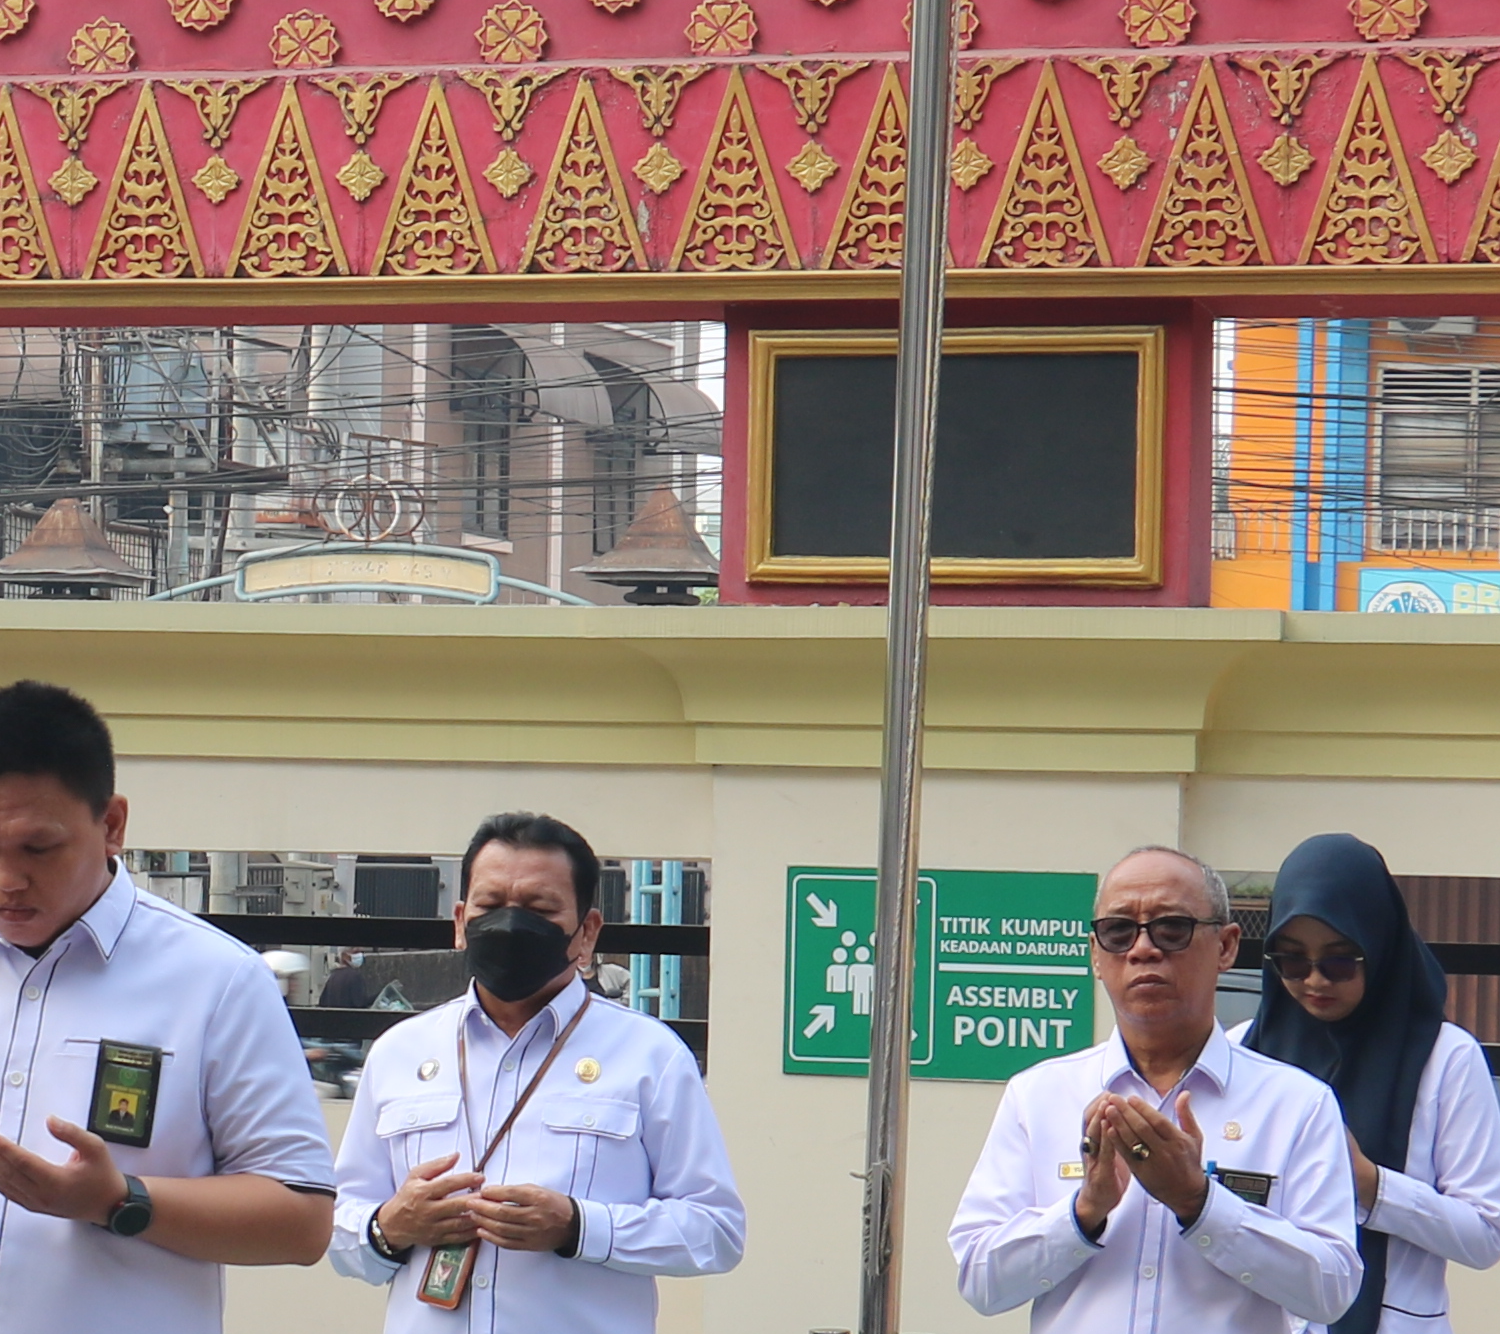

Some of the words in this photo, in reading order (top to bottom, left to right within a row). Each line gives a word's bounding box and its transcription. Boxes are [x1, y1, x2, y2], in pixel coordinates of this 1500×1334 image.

[940, 916, 991, 935] TITIK
[1001, 919, 1089, 937] KUMPUL
[940, 939, 1012, 954] KEADAAN
[1016, 942, 1088, 957] DARURAT
[946, 985, 1079, 1009] ASSEMBLY
[954, 1016, 1073, 1049] POINT
